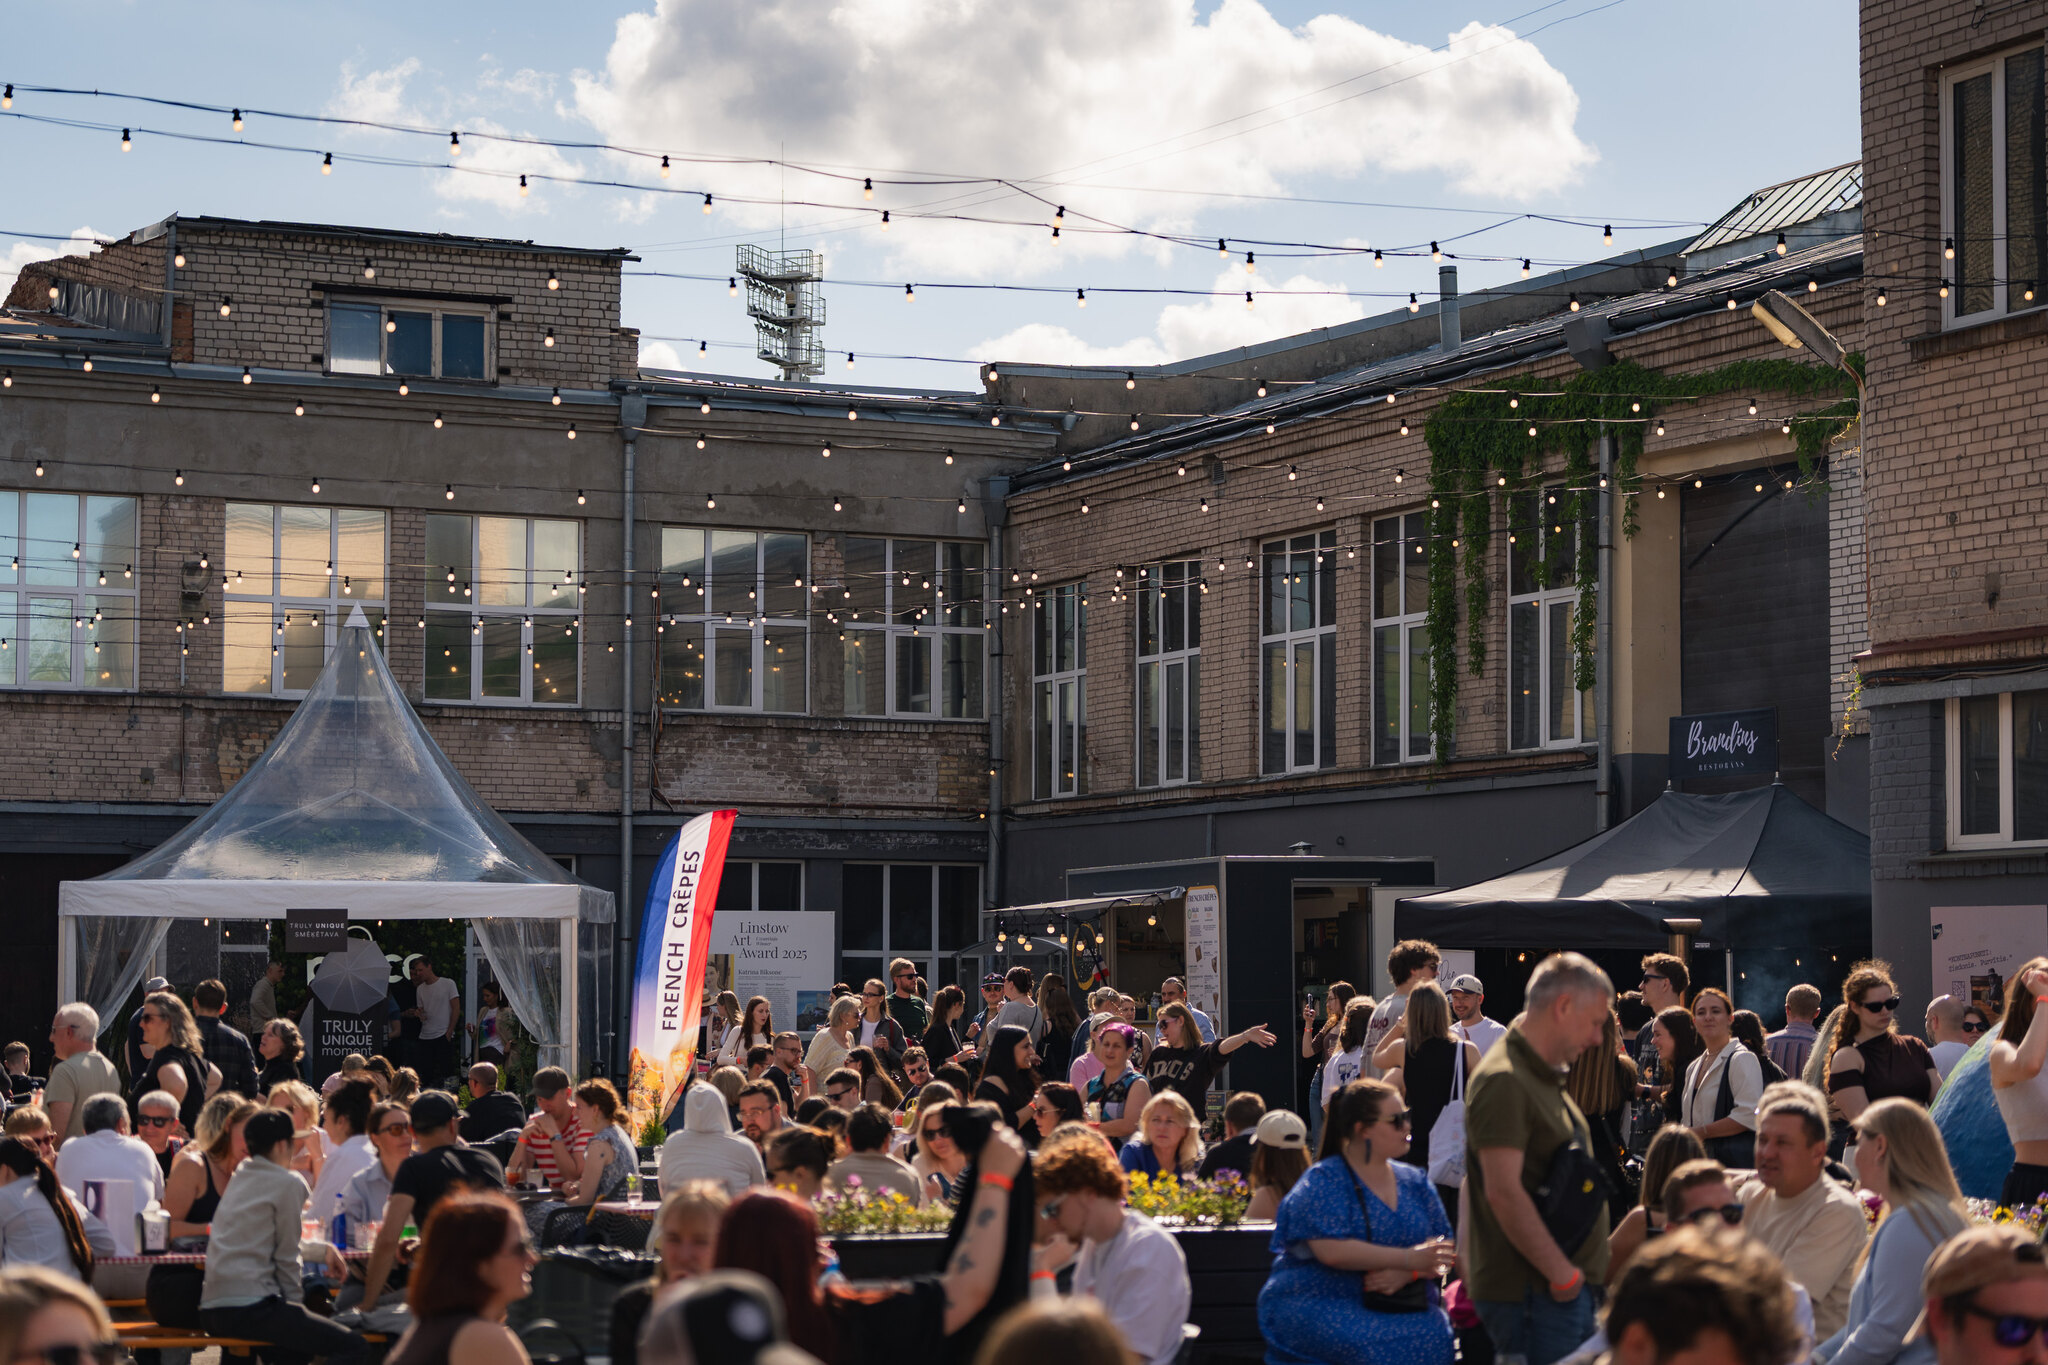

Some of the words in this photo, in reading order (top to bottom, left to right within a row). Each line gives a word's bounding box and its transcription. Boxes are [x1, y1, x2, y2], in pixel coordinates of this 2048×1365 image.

[672, 850, 701, 929] CRÊPES
[740, 921, 789, 934] Linstow
[730, 935, 752, 946] Art
[738, 947, 778, 959] Award
[782, 949, 808, 961] 2025
[662, 942, 685, 1031] FRENCH
[322, 1020, 373, 1033] TRULY
[322, 1035, 373, 1047] UNIQUE
[321, 1047, 373, 1057] moment
